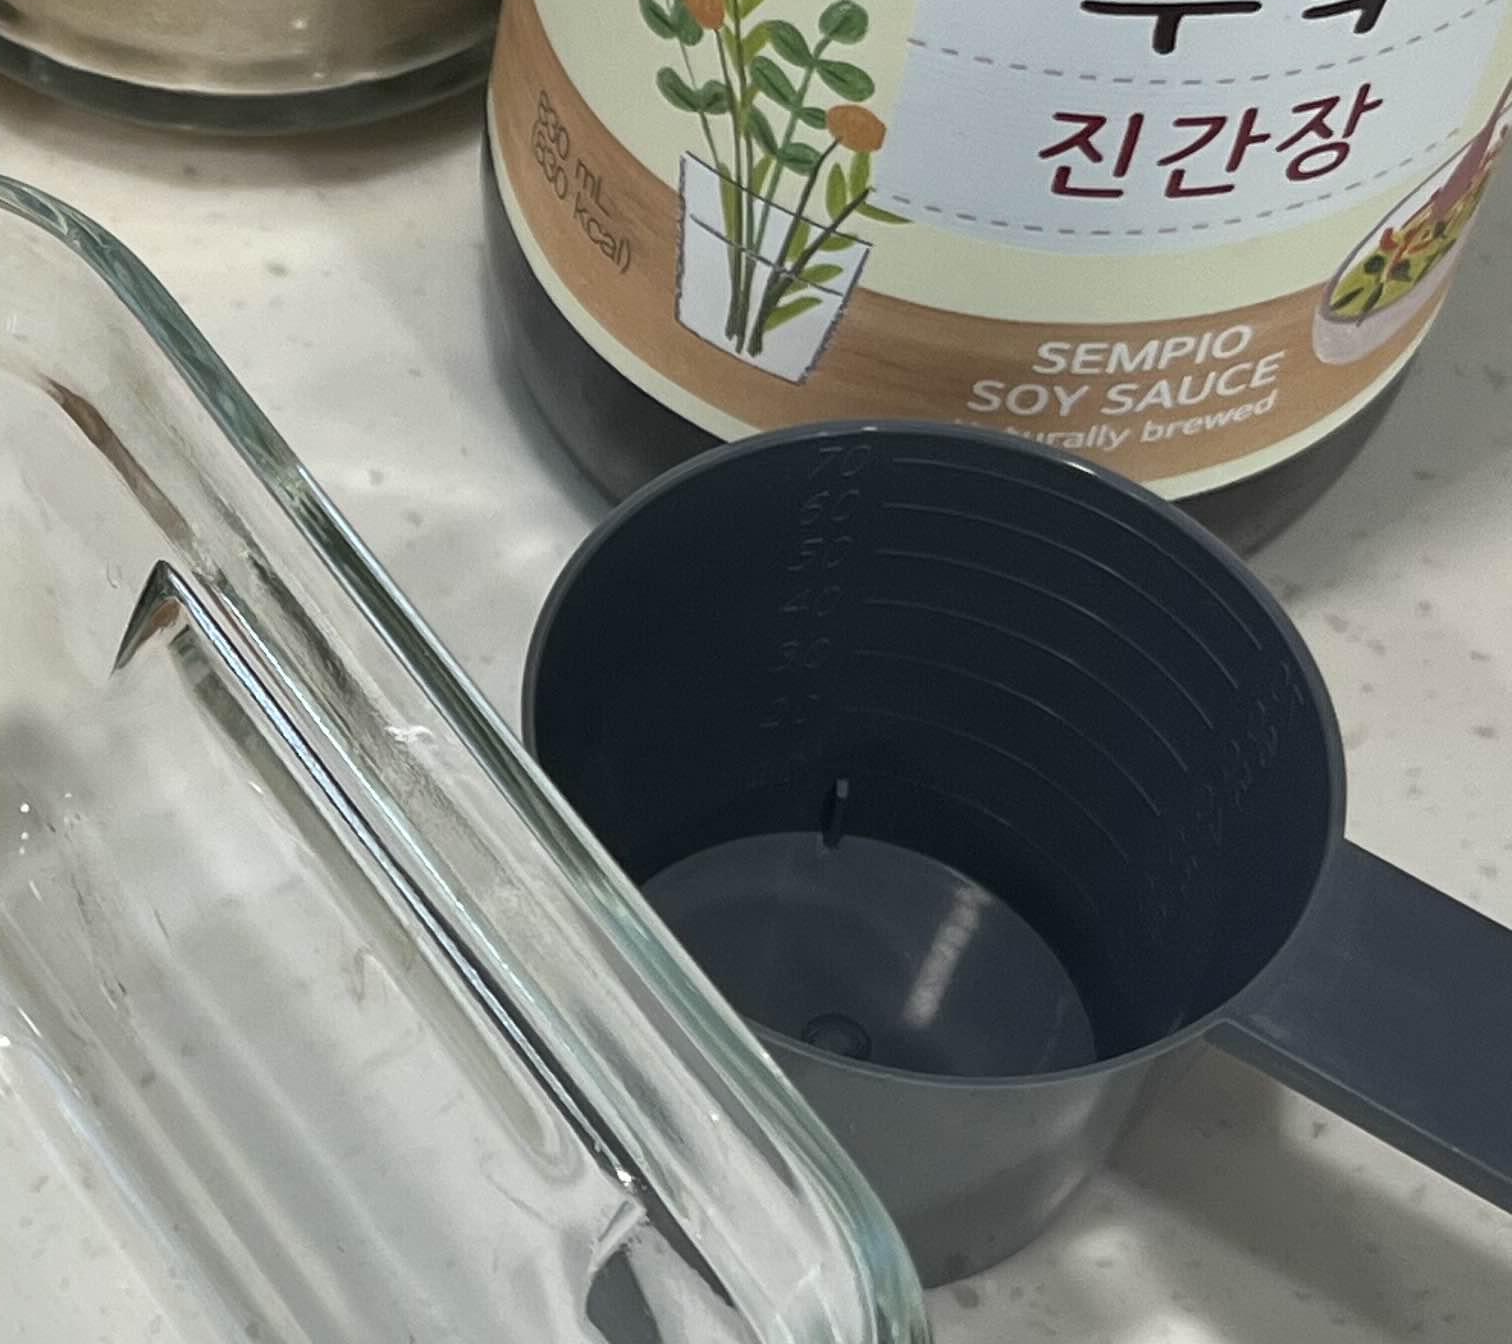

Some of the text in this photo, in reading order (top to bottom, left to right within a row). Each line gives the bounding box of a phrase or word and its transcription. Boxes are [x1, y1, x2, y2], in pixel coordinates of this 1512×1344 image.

[1038, 82, 1383, 200] 진간장
[1031, 323, 1253, 376] SEMPIO
[966, 350, 1286, 418] SOY SAUCE
[1140, 388, 1279, 444] brewed
